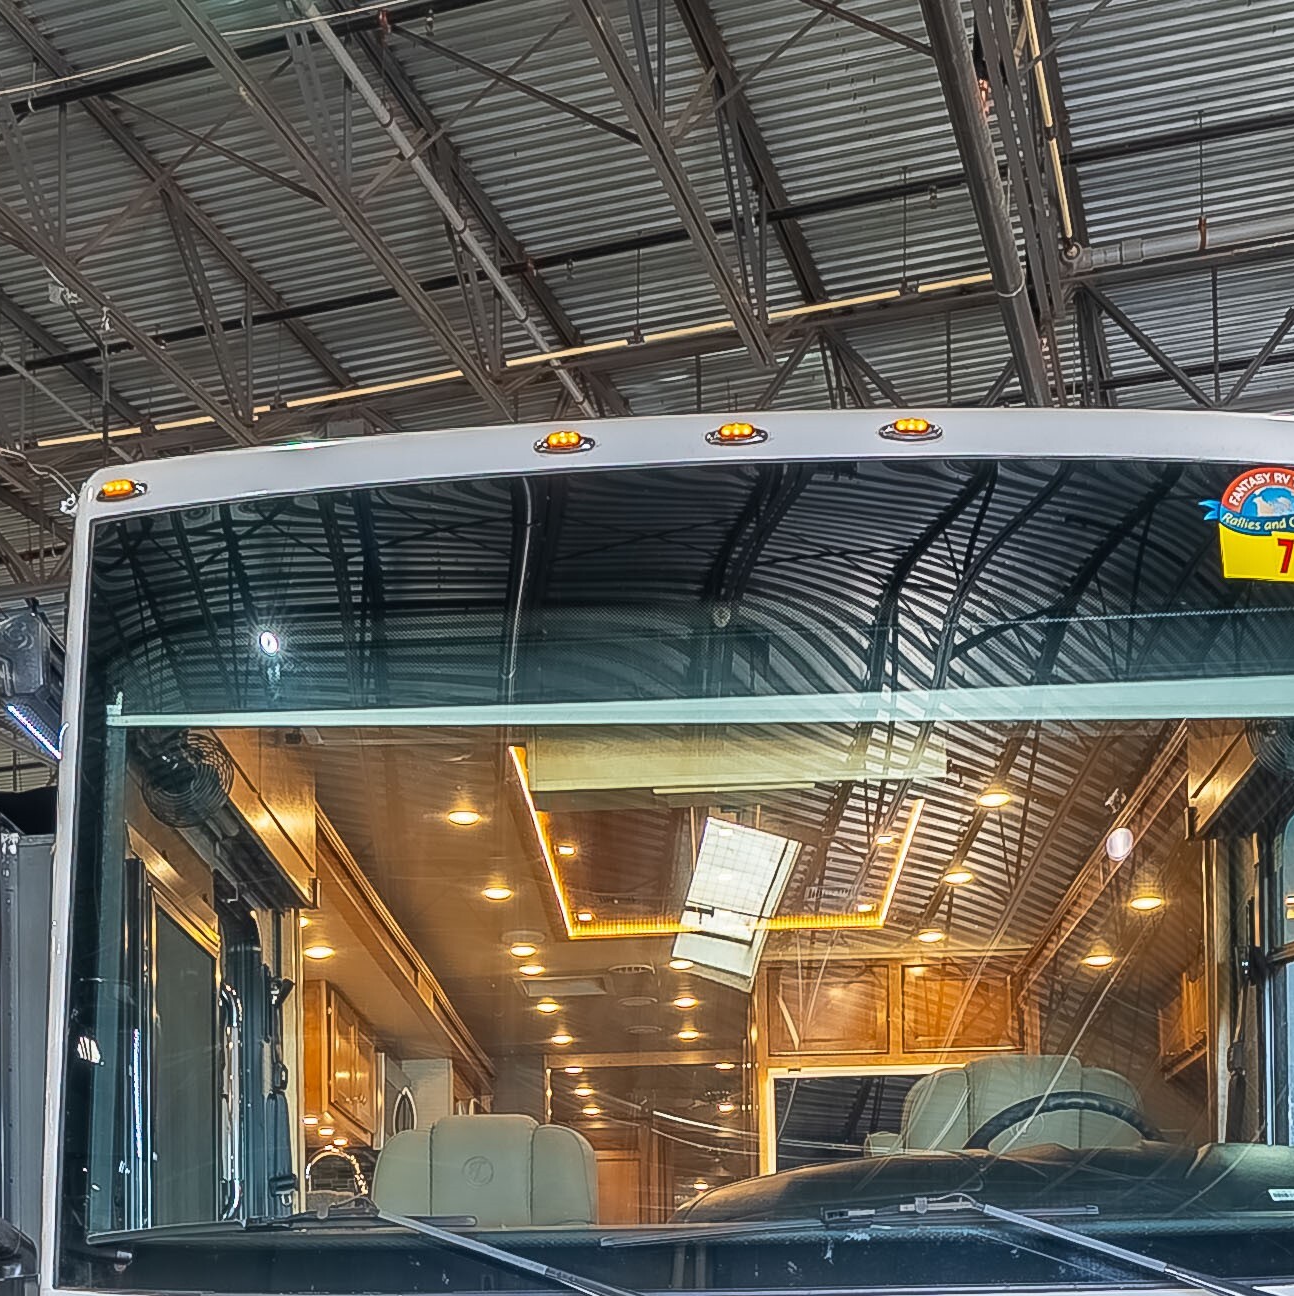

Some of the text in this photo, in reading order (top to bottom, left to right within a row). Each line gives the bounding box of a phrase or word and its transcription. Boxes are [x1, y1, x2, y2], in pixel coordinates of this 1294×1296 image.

[1228, 472, 1271, 506] FANTASY
[1273, 472, 1291, 485] RV
[1264, 517, 1287, 530] and
[1277, 538, 1294, 574] 7
